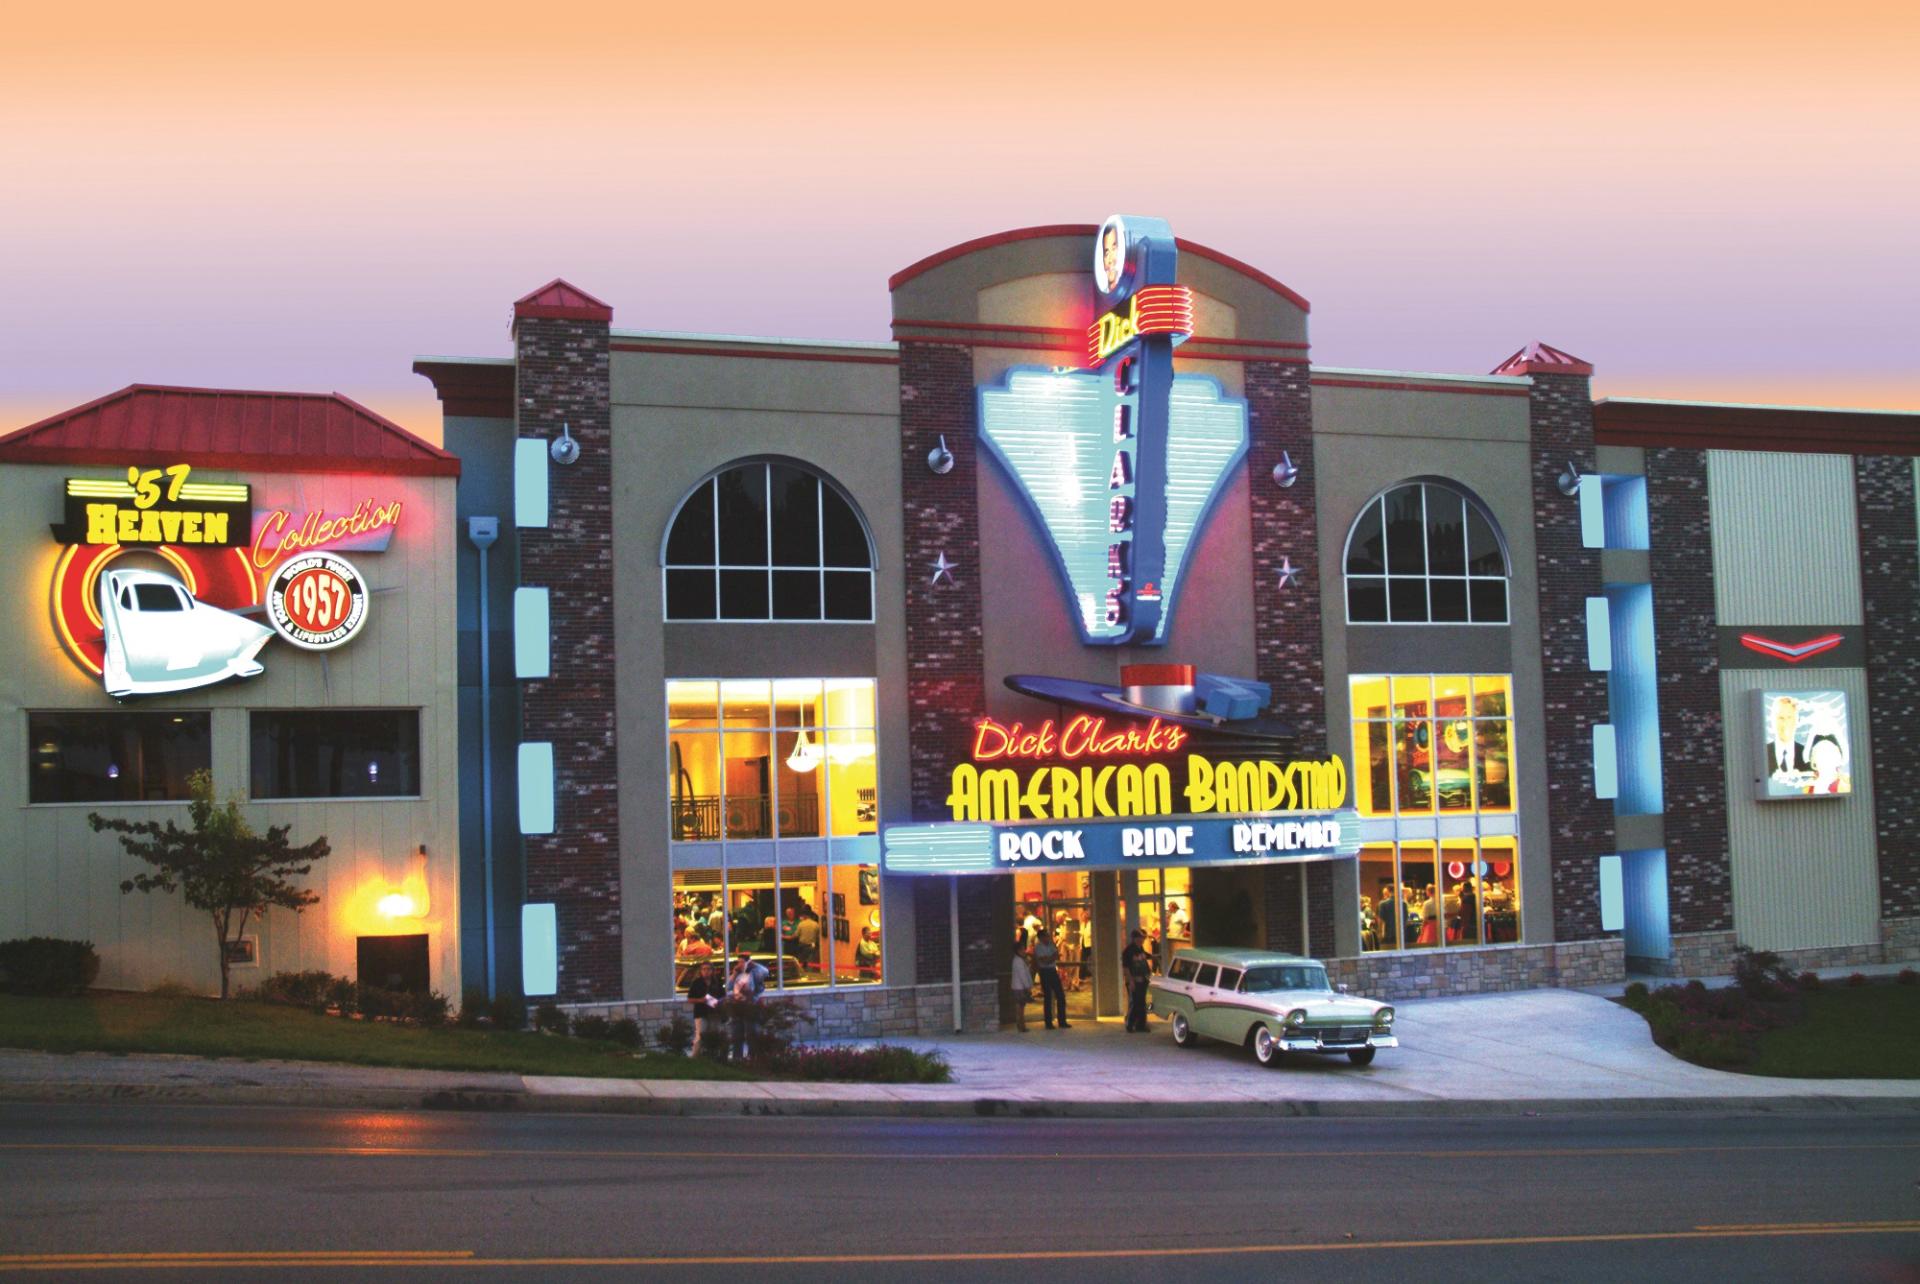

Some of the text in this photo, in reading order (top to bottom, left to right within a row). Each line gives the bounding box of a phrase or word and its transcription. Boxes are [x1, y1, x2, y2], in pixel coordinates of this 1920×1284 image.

[1098, 294, 1141, 358] Dick
[127, 464, 191, 508] '57
[86, 504, 229, 544] HEAVEN
[252, 499, 402, 568] Collection
[293, 574, 346, 626] 1957
[293, 627, 347, 643] LIFESTYLES
[974, 715, 1188, 760] Dick Clark's
[946, 753, 1346, 821] AMERICAN BANDSTAND
[1000, 831, 1085, 861] ROCK
[1121, 826, 1194, 857] RIDE
